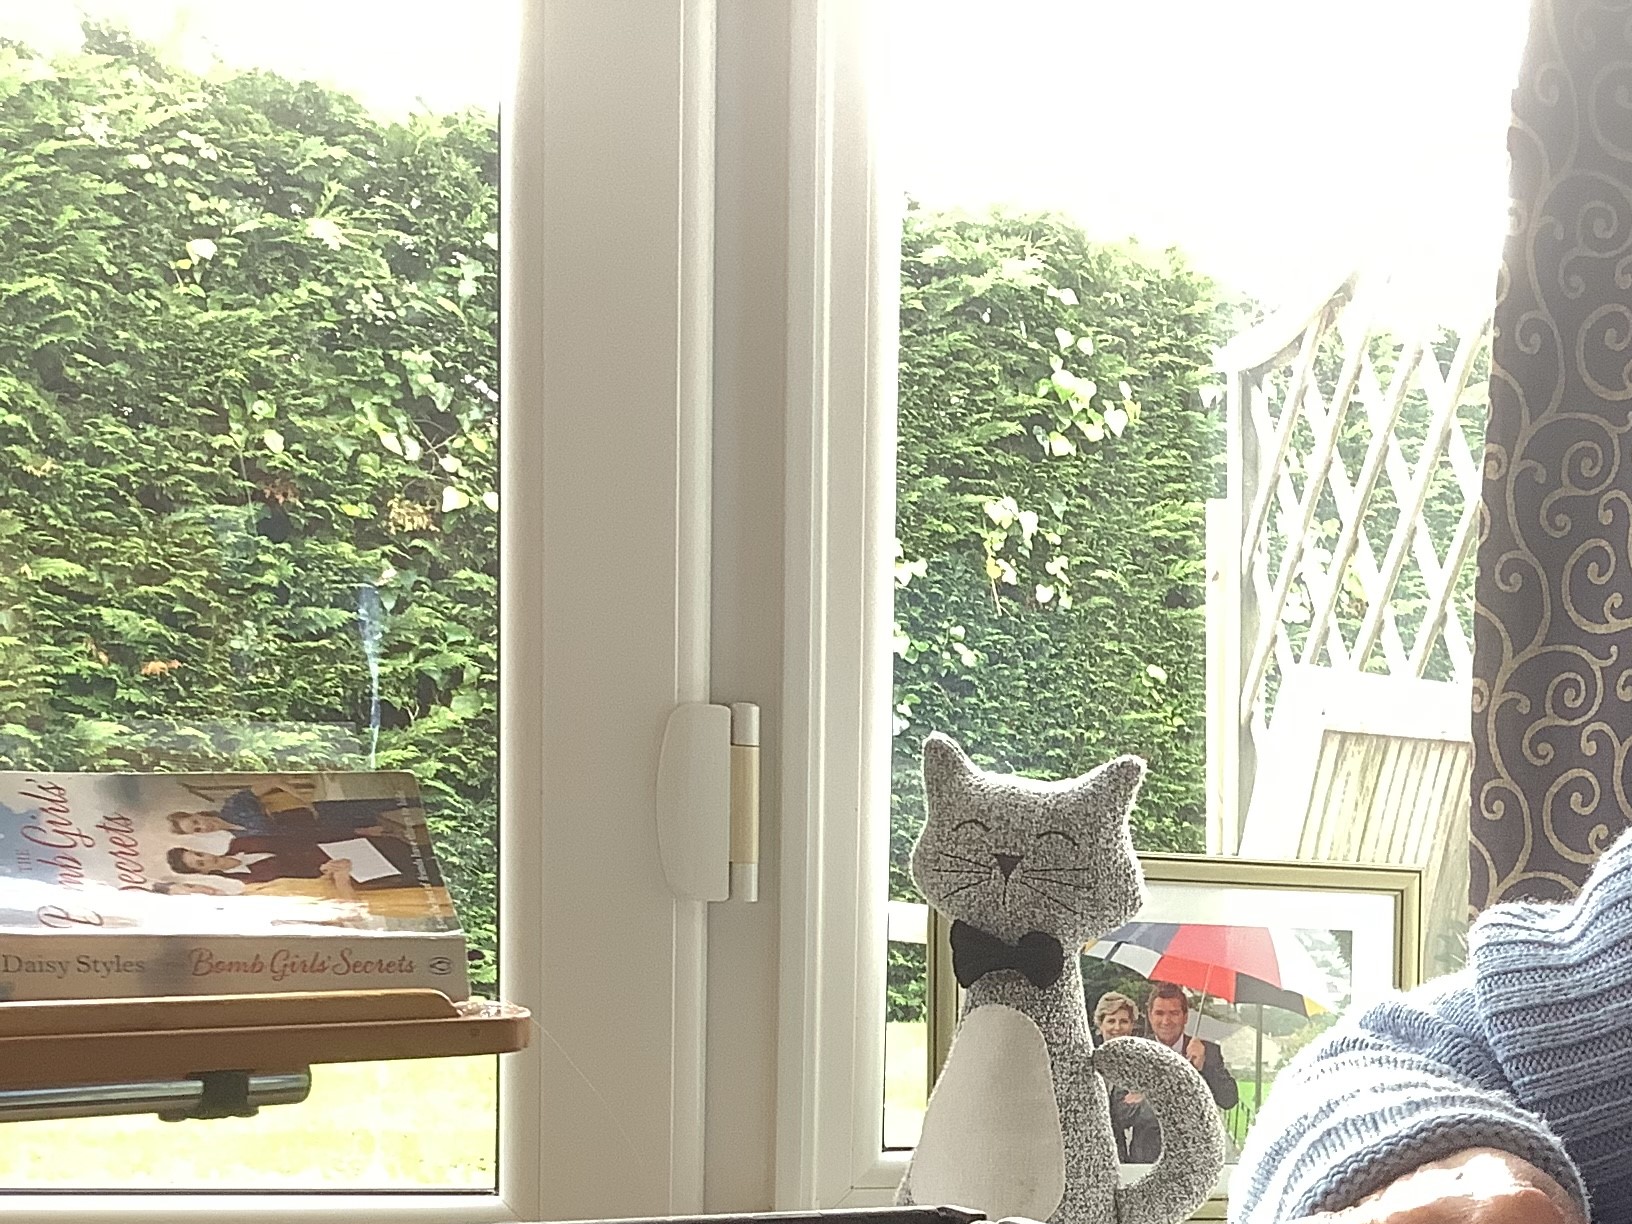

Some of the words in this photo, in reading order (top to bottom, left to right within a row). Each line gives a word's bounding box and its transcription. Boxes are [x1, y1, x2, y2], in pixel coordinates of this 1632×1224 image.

[18, 778, 95, 849] Girls'
[36, 852, 104, 929] Bmb
[2, 954, 69, 979] Daisy
[76, 954, 146, 979] Styles
[188, 947, 264, 977] Bomb
[332, 947, 417, 976] Secrets
